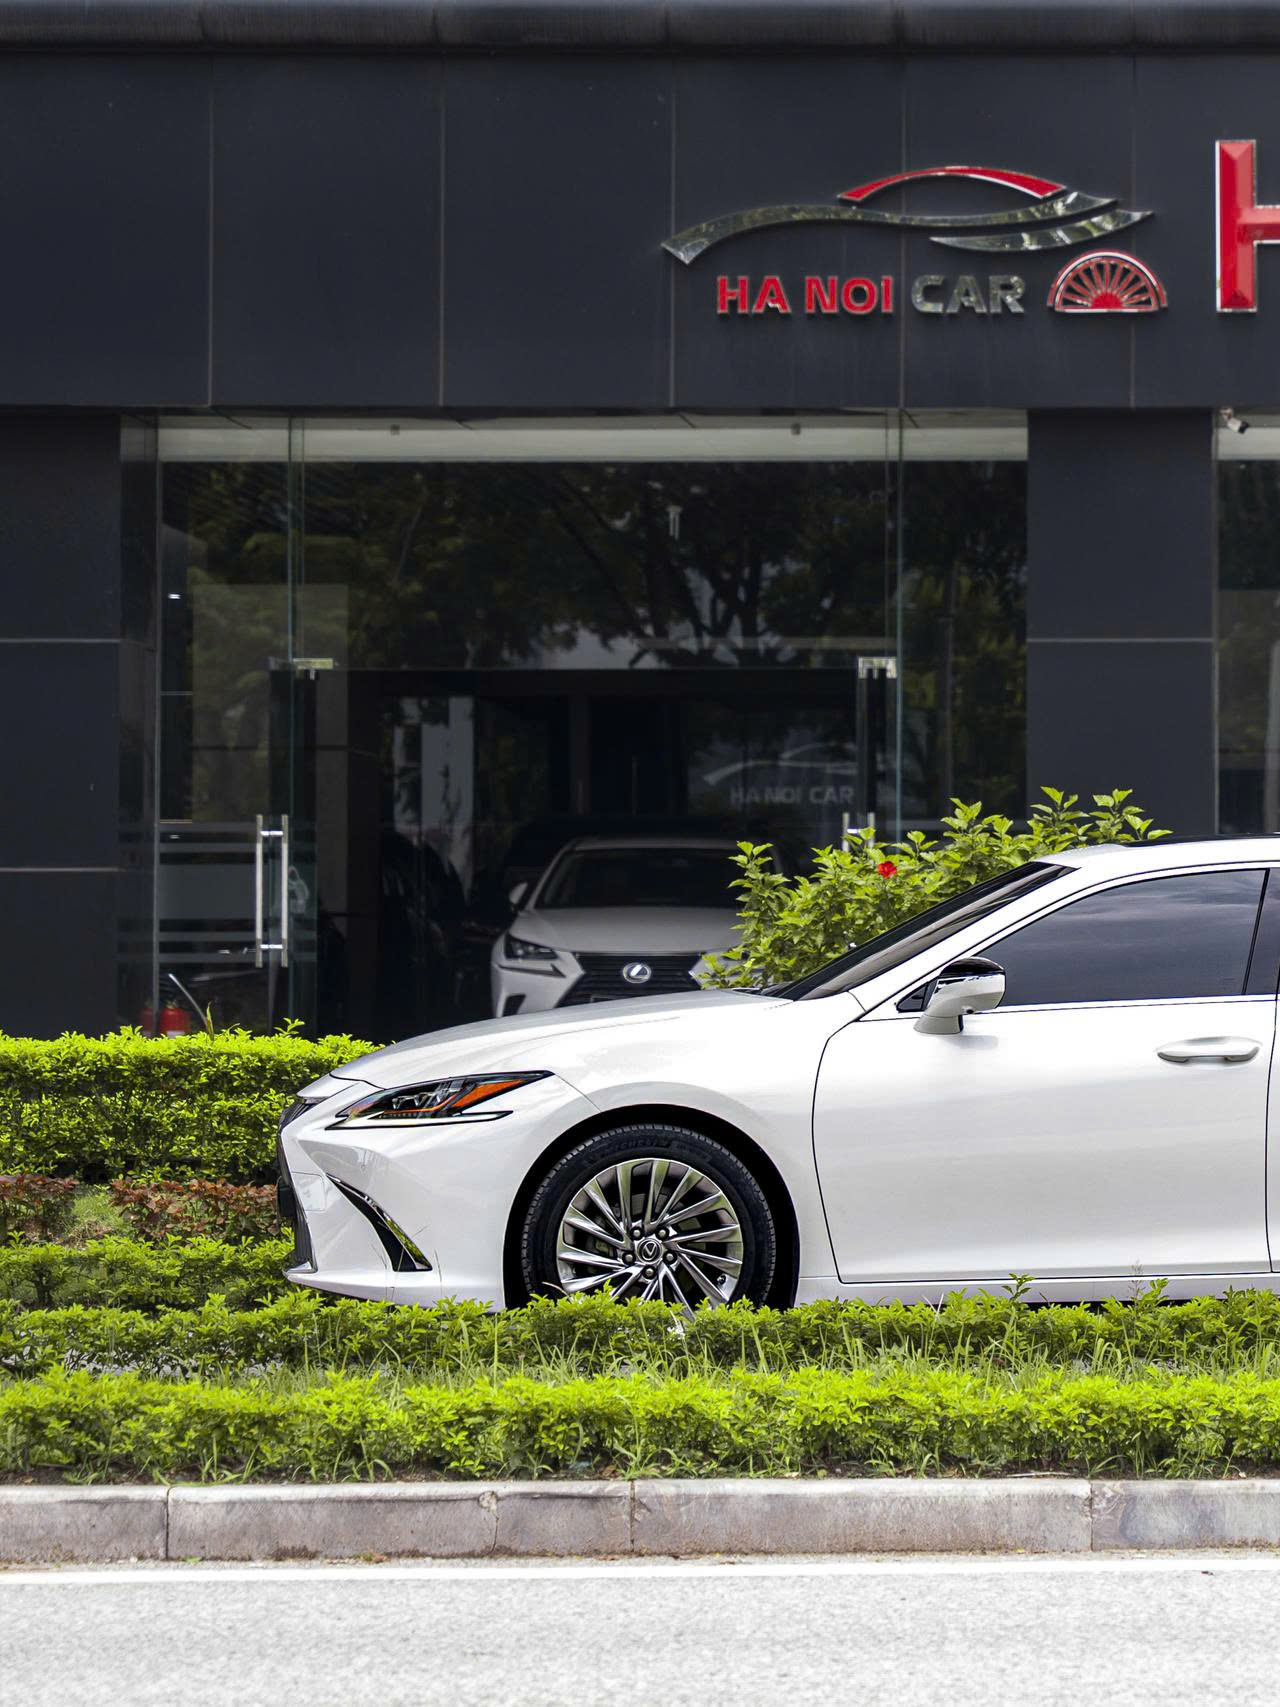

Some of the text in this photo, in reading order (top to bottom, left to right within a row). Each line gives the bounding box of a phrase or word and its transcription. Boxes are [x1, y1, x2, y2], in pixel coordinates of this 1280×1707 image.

[716, 275, 1025, 314] HA NOI CAR
[809, 786, 854, 804] CAR
